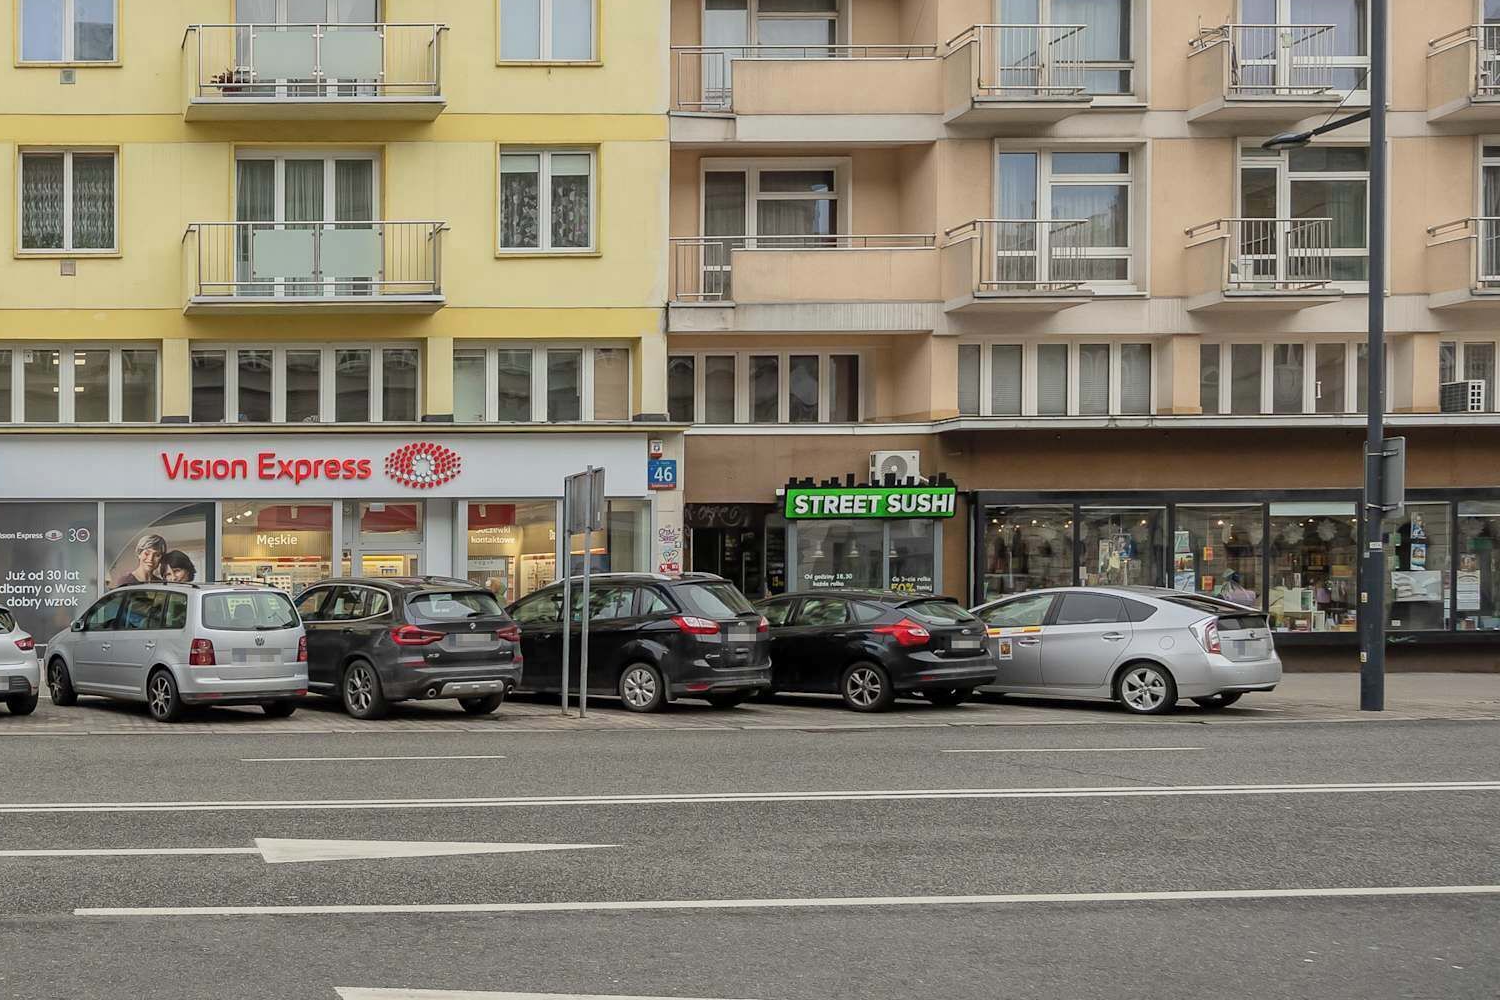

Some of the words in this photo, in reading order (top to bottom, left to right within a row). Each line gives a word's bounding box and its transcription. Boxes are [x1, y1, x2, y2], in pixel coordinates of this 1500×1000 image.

[162, 453, 248, 480] Vision
[258, 453, 372, 485] Express
[654, 466, 673, 482] 46
[795, 495, 882, 514] STREET
[887, 494, 954, 513] SUSHI
[16, 531, 43, 541] Express
[256, 534, 298, 548] Męskie
[471, 535, 515, 544] kontaktowe
[5, 570, 26, 581] Już
[28, 570, 44, 581] od
[46, 570, 62, 581] 30
[64, 570, 80, 581] lat
[44, 586, 53, 594] o
[54, 583, 87, 594] Wasz
[6, 596, 42, 610] dobry
[44, 596, 79, 607] wzrok
